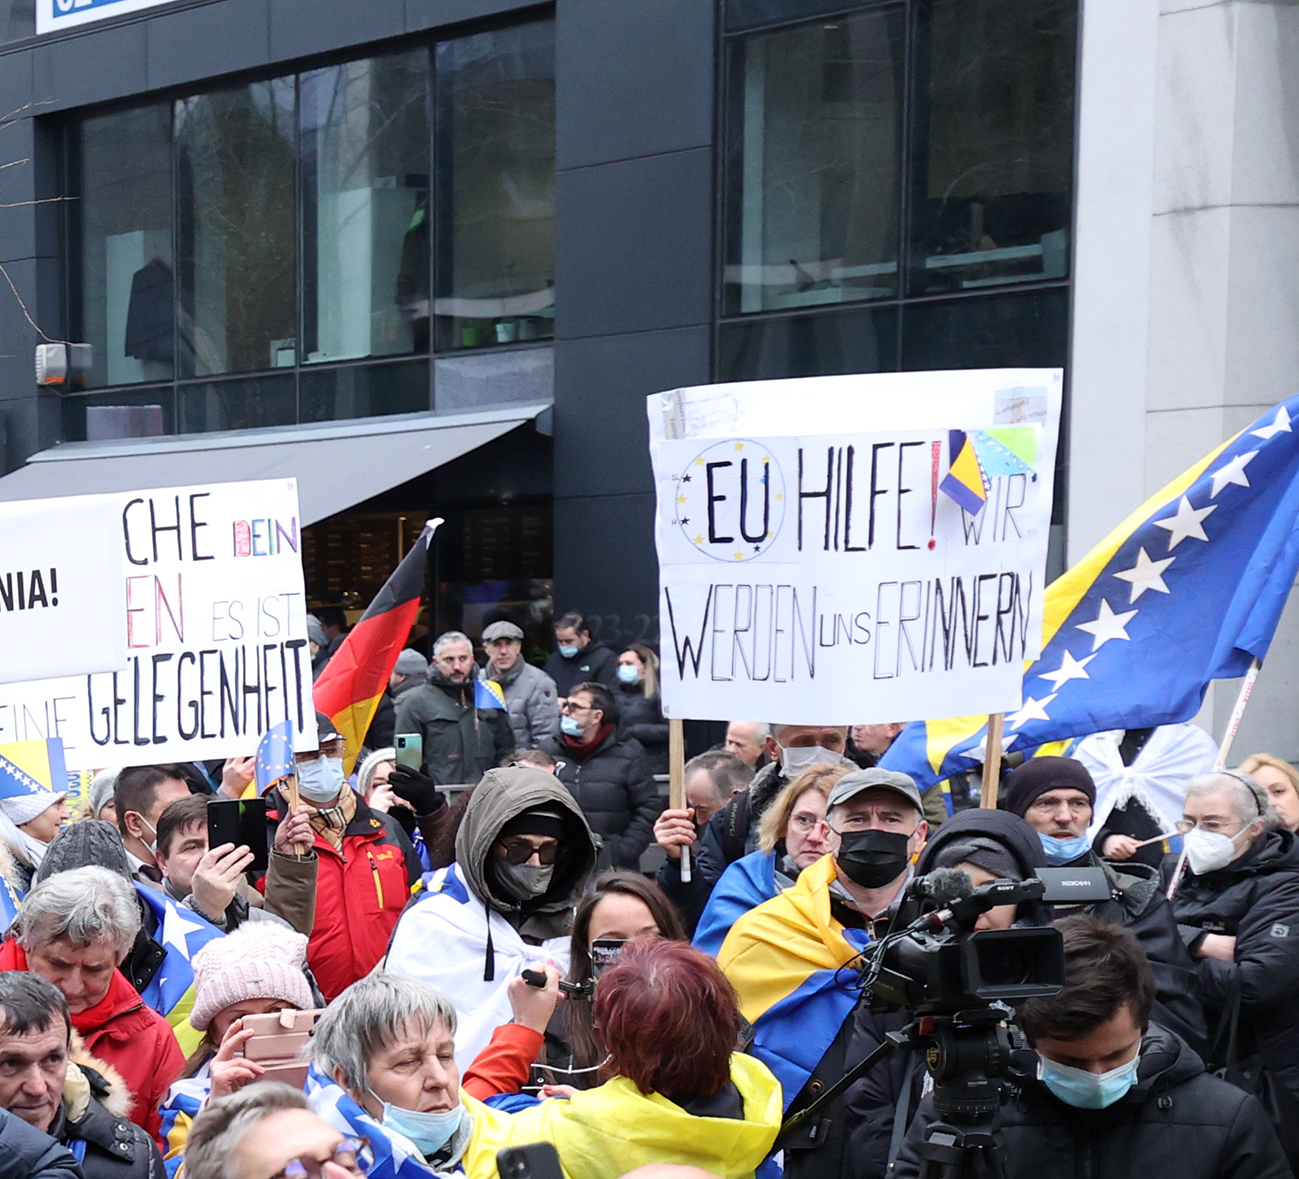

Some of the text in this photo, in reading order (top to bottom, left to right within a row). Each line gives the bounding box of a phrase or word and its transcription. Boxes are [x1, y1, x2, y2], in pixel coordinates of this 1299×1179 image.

[122, 493, 298, 565] CHE DEIN
[706, 441, 1027, 551] EU HILFE! WIR
[126, 573, 300, 648] EN ES IST
[665, 570, 1033, 682] WERDEN UNS ERINNERN
[88, 639, 307, 746] GELEGENHEIT
